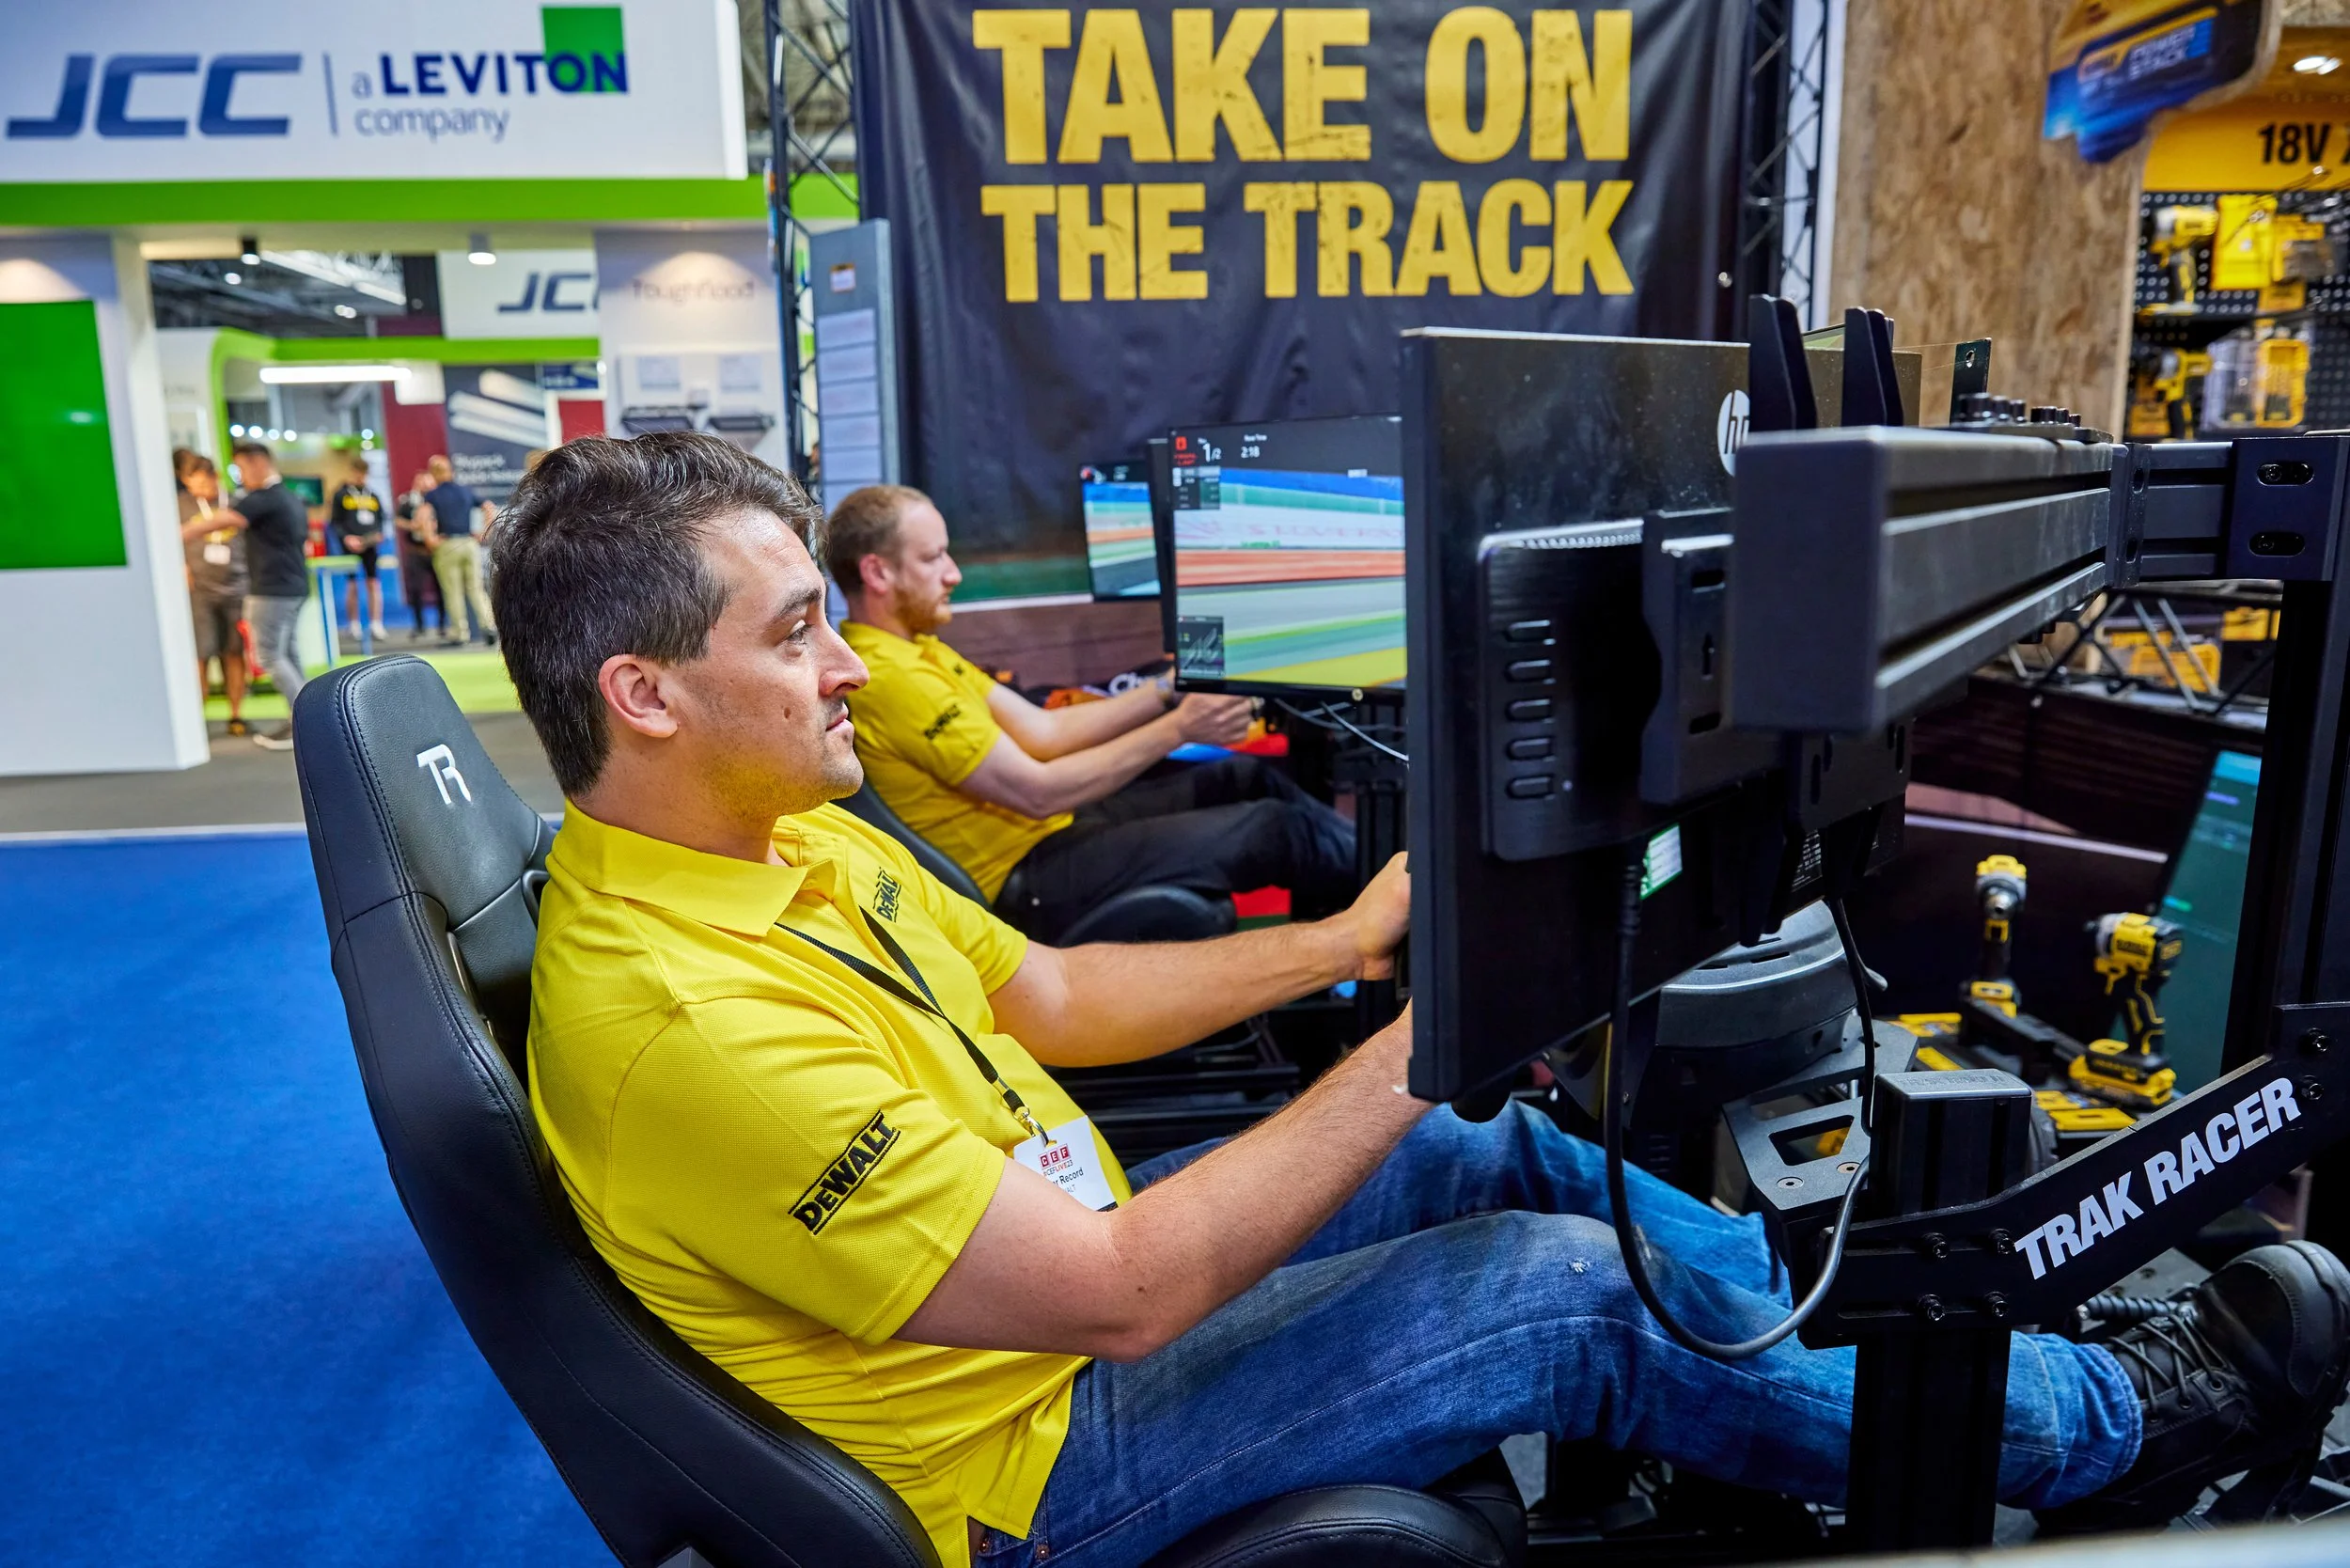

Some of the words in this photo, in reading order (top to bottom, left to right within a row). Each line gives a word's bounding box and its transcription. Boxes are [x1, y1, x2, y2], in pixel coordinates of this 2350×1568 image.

[6, 54, 303, 139] JCC
[352, 71, 372, 98] a
[381, 53, 629, 94] LEVITON
[973, 8, 1371, 164] TAKE
[1425, 8, 1631, 164] ON
[355, 105, 509, 143] company
[2258, 123, 2330, 165] 18V
[981, 183, 1209, 303] THE
[1244, 180, 1635, 297] TRACK
[497, 271, 598, 312] JC
[876, 871, 899, 922] DEWAL
[791, 1111, 895, 1232] DEWALT
[1040, 1145, 1070, 1168] CEF
[1059, 1167, 1084, 1184] Record
[2014, 1171, 2144, 1279] TRAK
[2144, 1078, 2302, 1205] RACER
